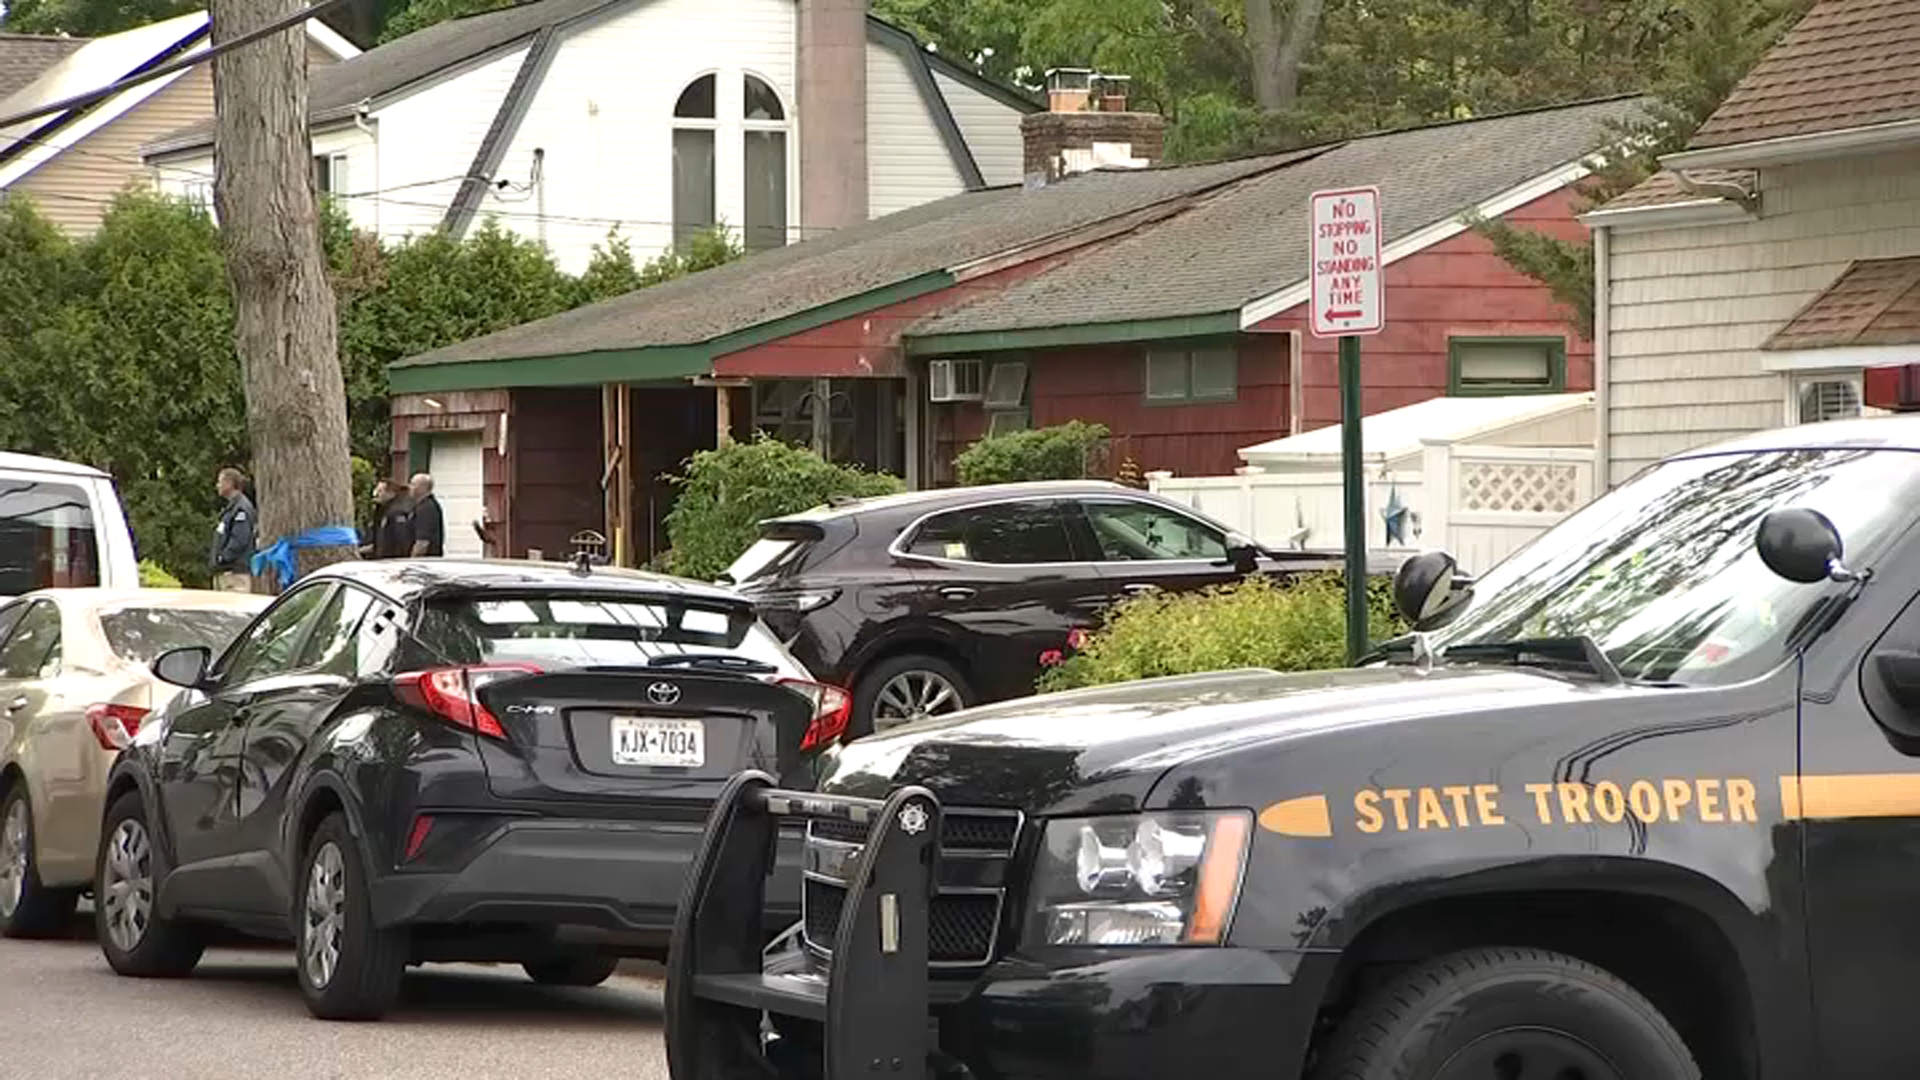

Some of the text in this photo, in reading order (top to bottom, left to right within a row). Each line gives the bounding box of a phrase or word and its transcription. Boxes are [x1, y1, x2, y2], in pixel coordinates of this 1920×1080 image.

[1332, 203, 1355, 219] NO
[1319, 220, 1371, 238] STOPPING
[1333, 240, 1357, 256] NO
[1317, 257, 1374, 275] STANDING
[1331, 275, 1361, 290] ANY
[1330, 290, 1363, 305] TIME
[1354, 778, 1758, 833] STATE TROOPER
